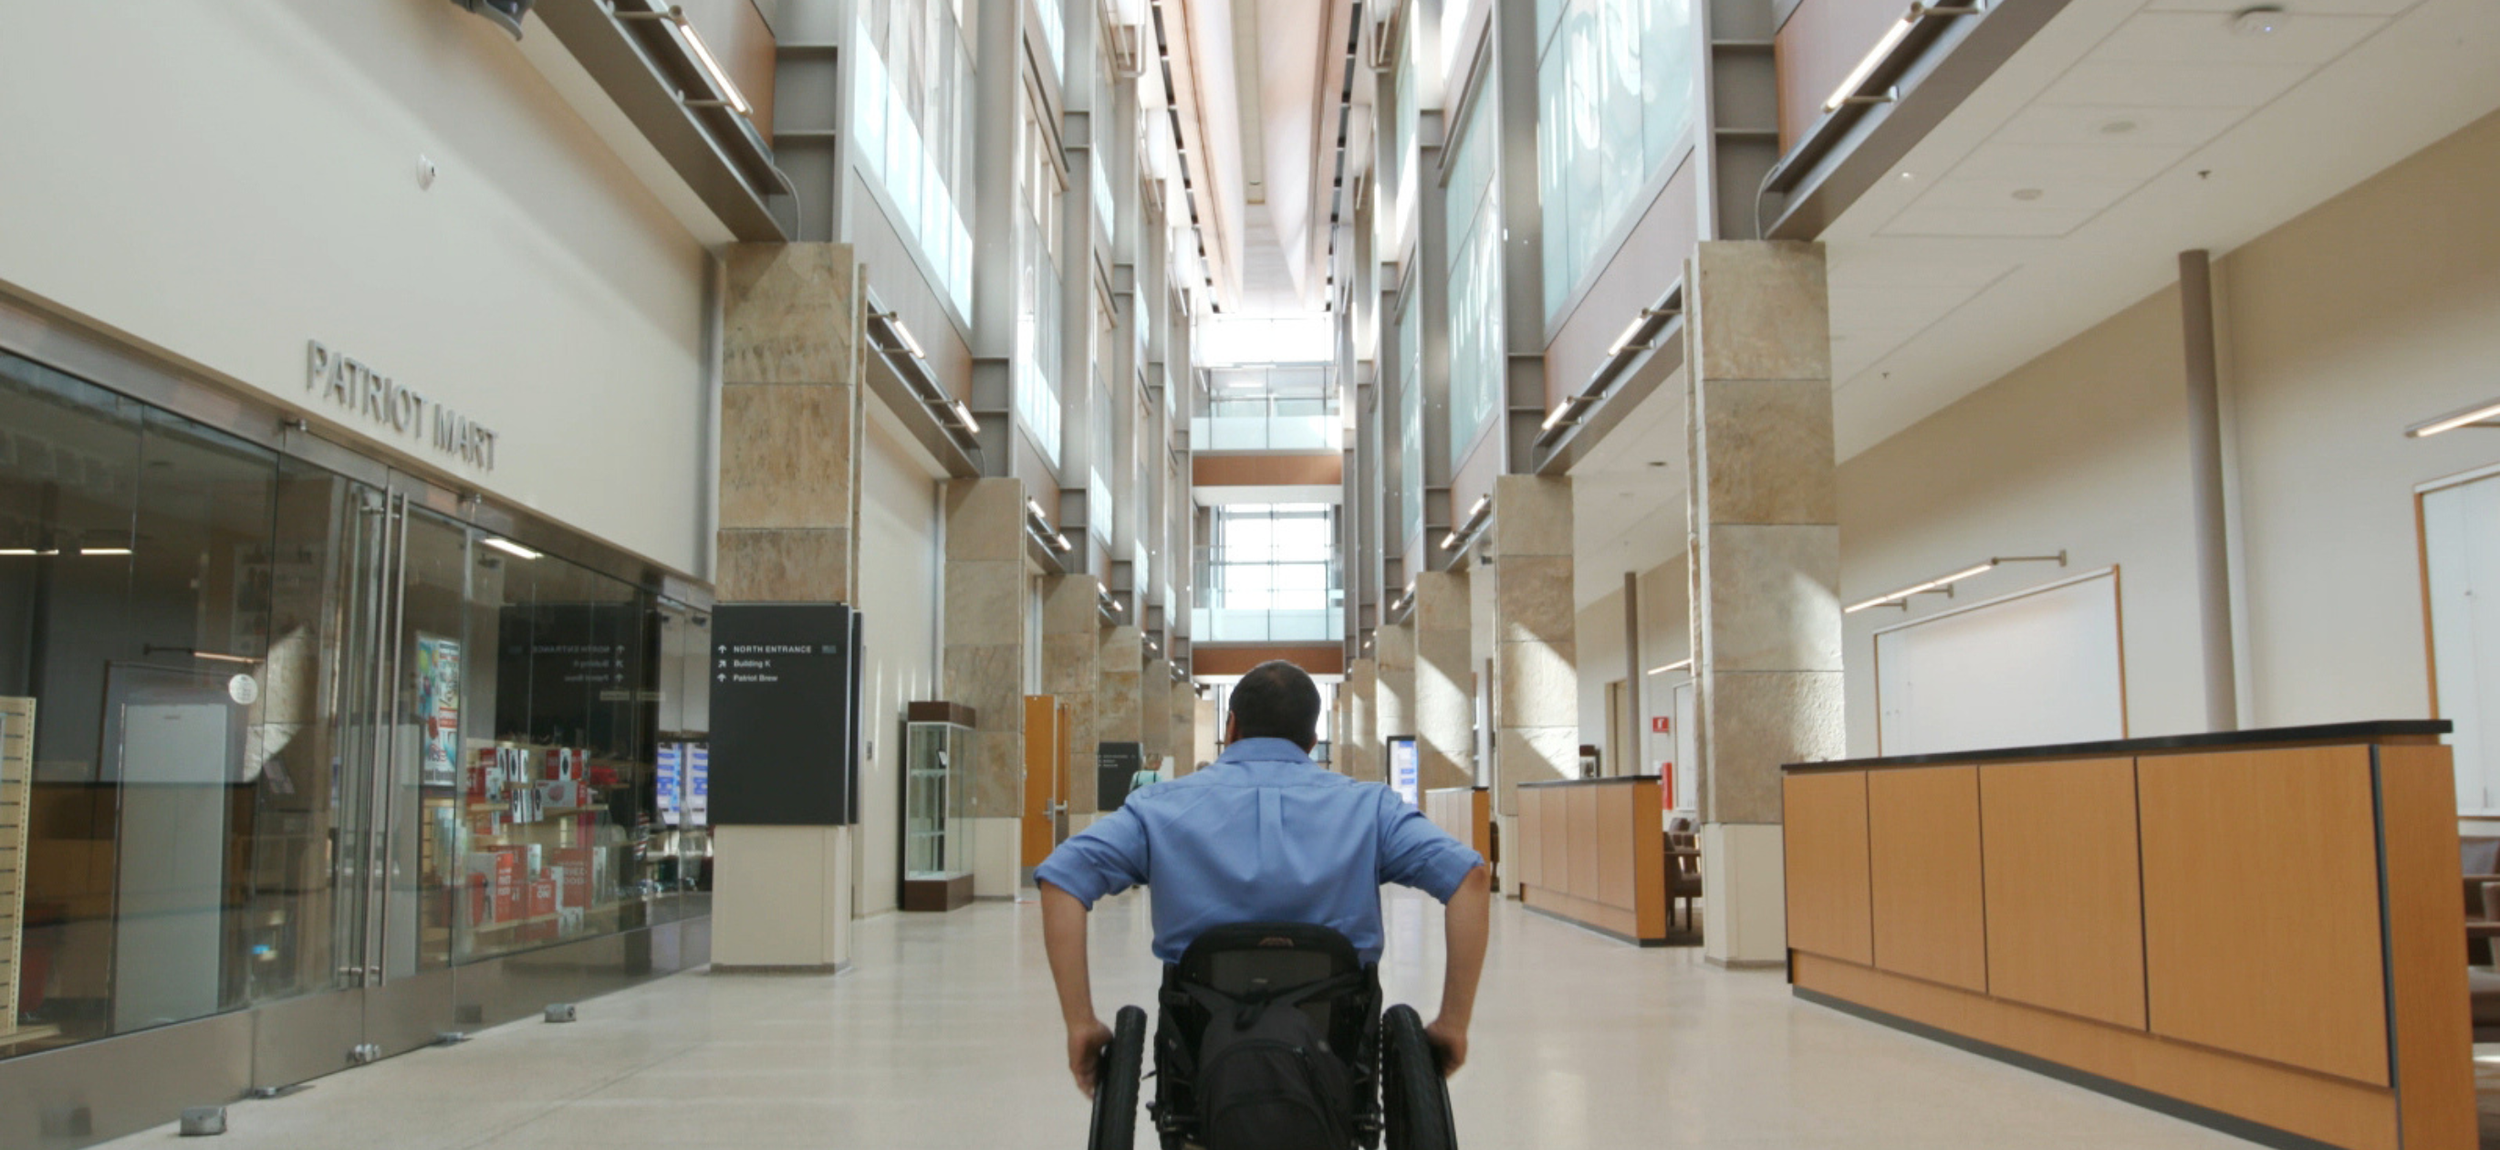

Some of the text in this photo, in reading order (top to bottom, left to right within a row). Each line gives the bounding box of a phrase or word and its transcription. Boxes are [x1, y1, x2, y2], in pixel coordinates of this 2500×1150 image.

[306, 338, 499, 471] PATRIOT MART
[733, 645, 812, 654] NORTH ENTRANCE
[733, 659, 771, 669] Building K
[733, 673, 778, 682] Patriot Brew
